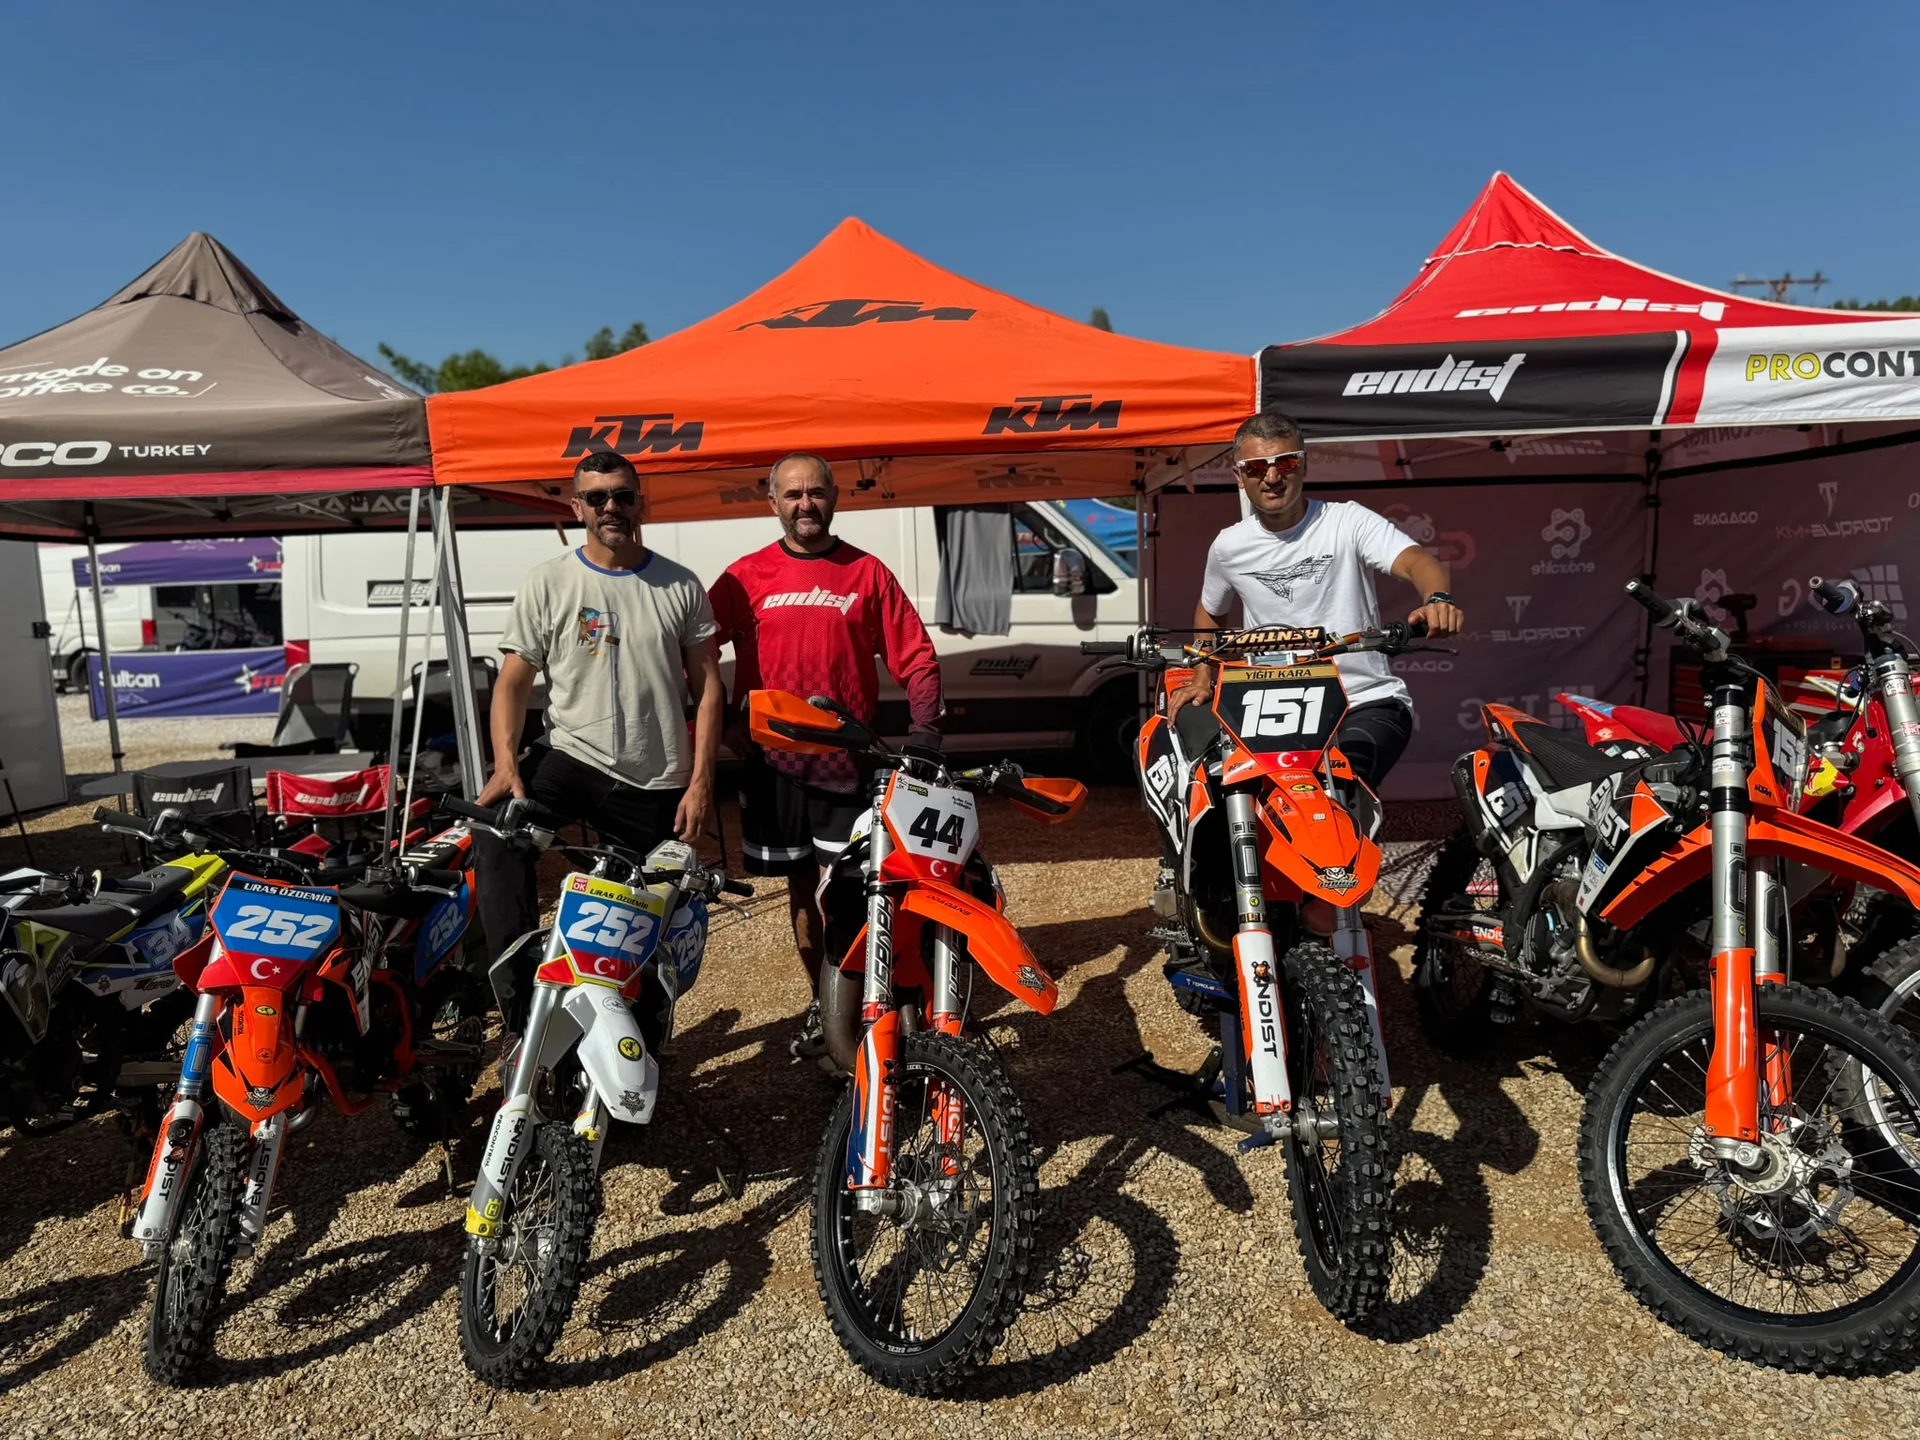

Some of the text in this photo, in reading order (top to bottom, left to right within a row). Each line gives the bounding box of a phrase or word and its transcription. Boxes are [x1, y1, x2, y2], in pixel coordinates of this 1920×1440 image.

[735, 299, 977, 331] KTM
[1455, 295, 1730, 321] endist
[0, 377, 113, 398] offee
[137, 368, 203, 381] on
[1341, 353, 1526, 402] endist
[981, 394, 1122, 435] KTM
[561, 414, 704, 459] KTM
[0, 441, 212, 467] CO TURKEY
[85, 562, 121, 573] Sltan
[762, 585, 858, 616] endist
[1222, 628, 1320, 645] RENTHAL
[1277, 669, 1311, 679] KARA
[1240, 686, 1325, 738] 151
[152, 782, 224, 804] endist
[294, 783, 369, 806] endist
[1754, 785, 1772, 797] KTM
[908, 806, 965, 855] 44
[243, 882, 332, 904] URAS ÖZDEMİR
[573, 883, 586, 892] OK
[590, 889, 614, 900] URAS
[147, 913, 192, 968] 34
[225, 904, 334, 949] 252
[429, 902, 464, 952] 252
[565, 901, 654, 956] 252
[1472, 925, 1504, 942] ENDIS
[1256, 978, 1278, 1059] NDIST
[879, 1085, 896, 1155] DIST
[485, 1114, 504, 1168] PROCONTROL
[496, 1117, 526, 1189] ENDIST
[158, 1160, 180, 1202] DIST
[250, 1143, 272, 1207] ENDIST
